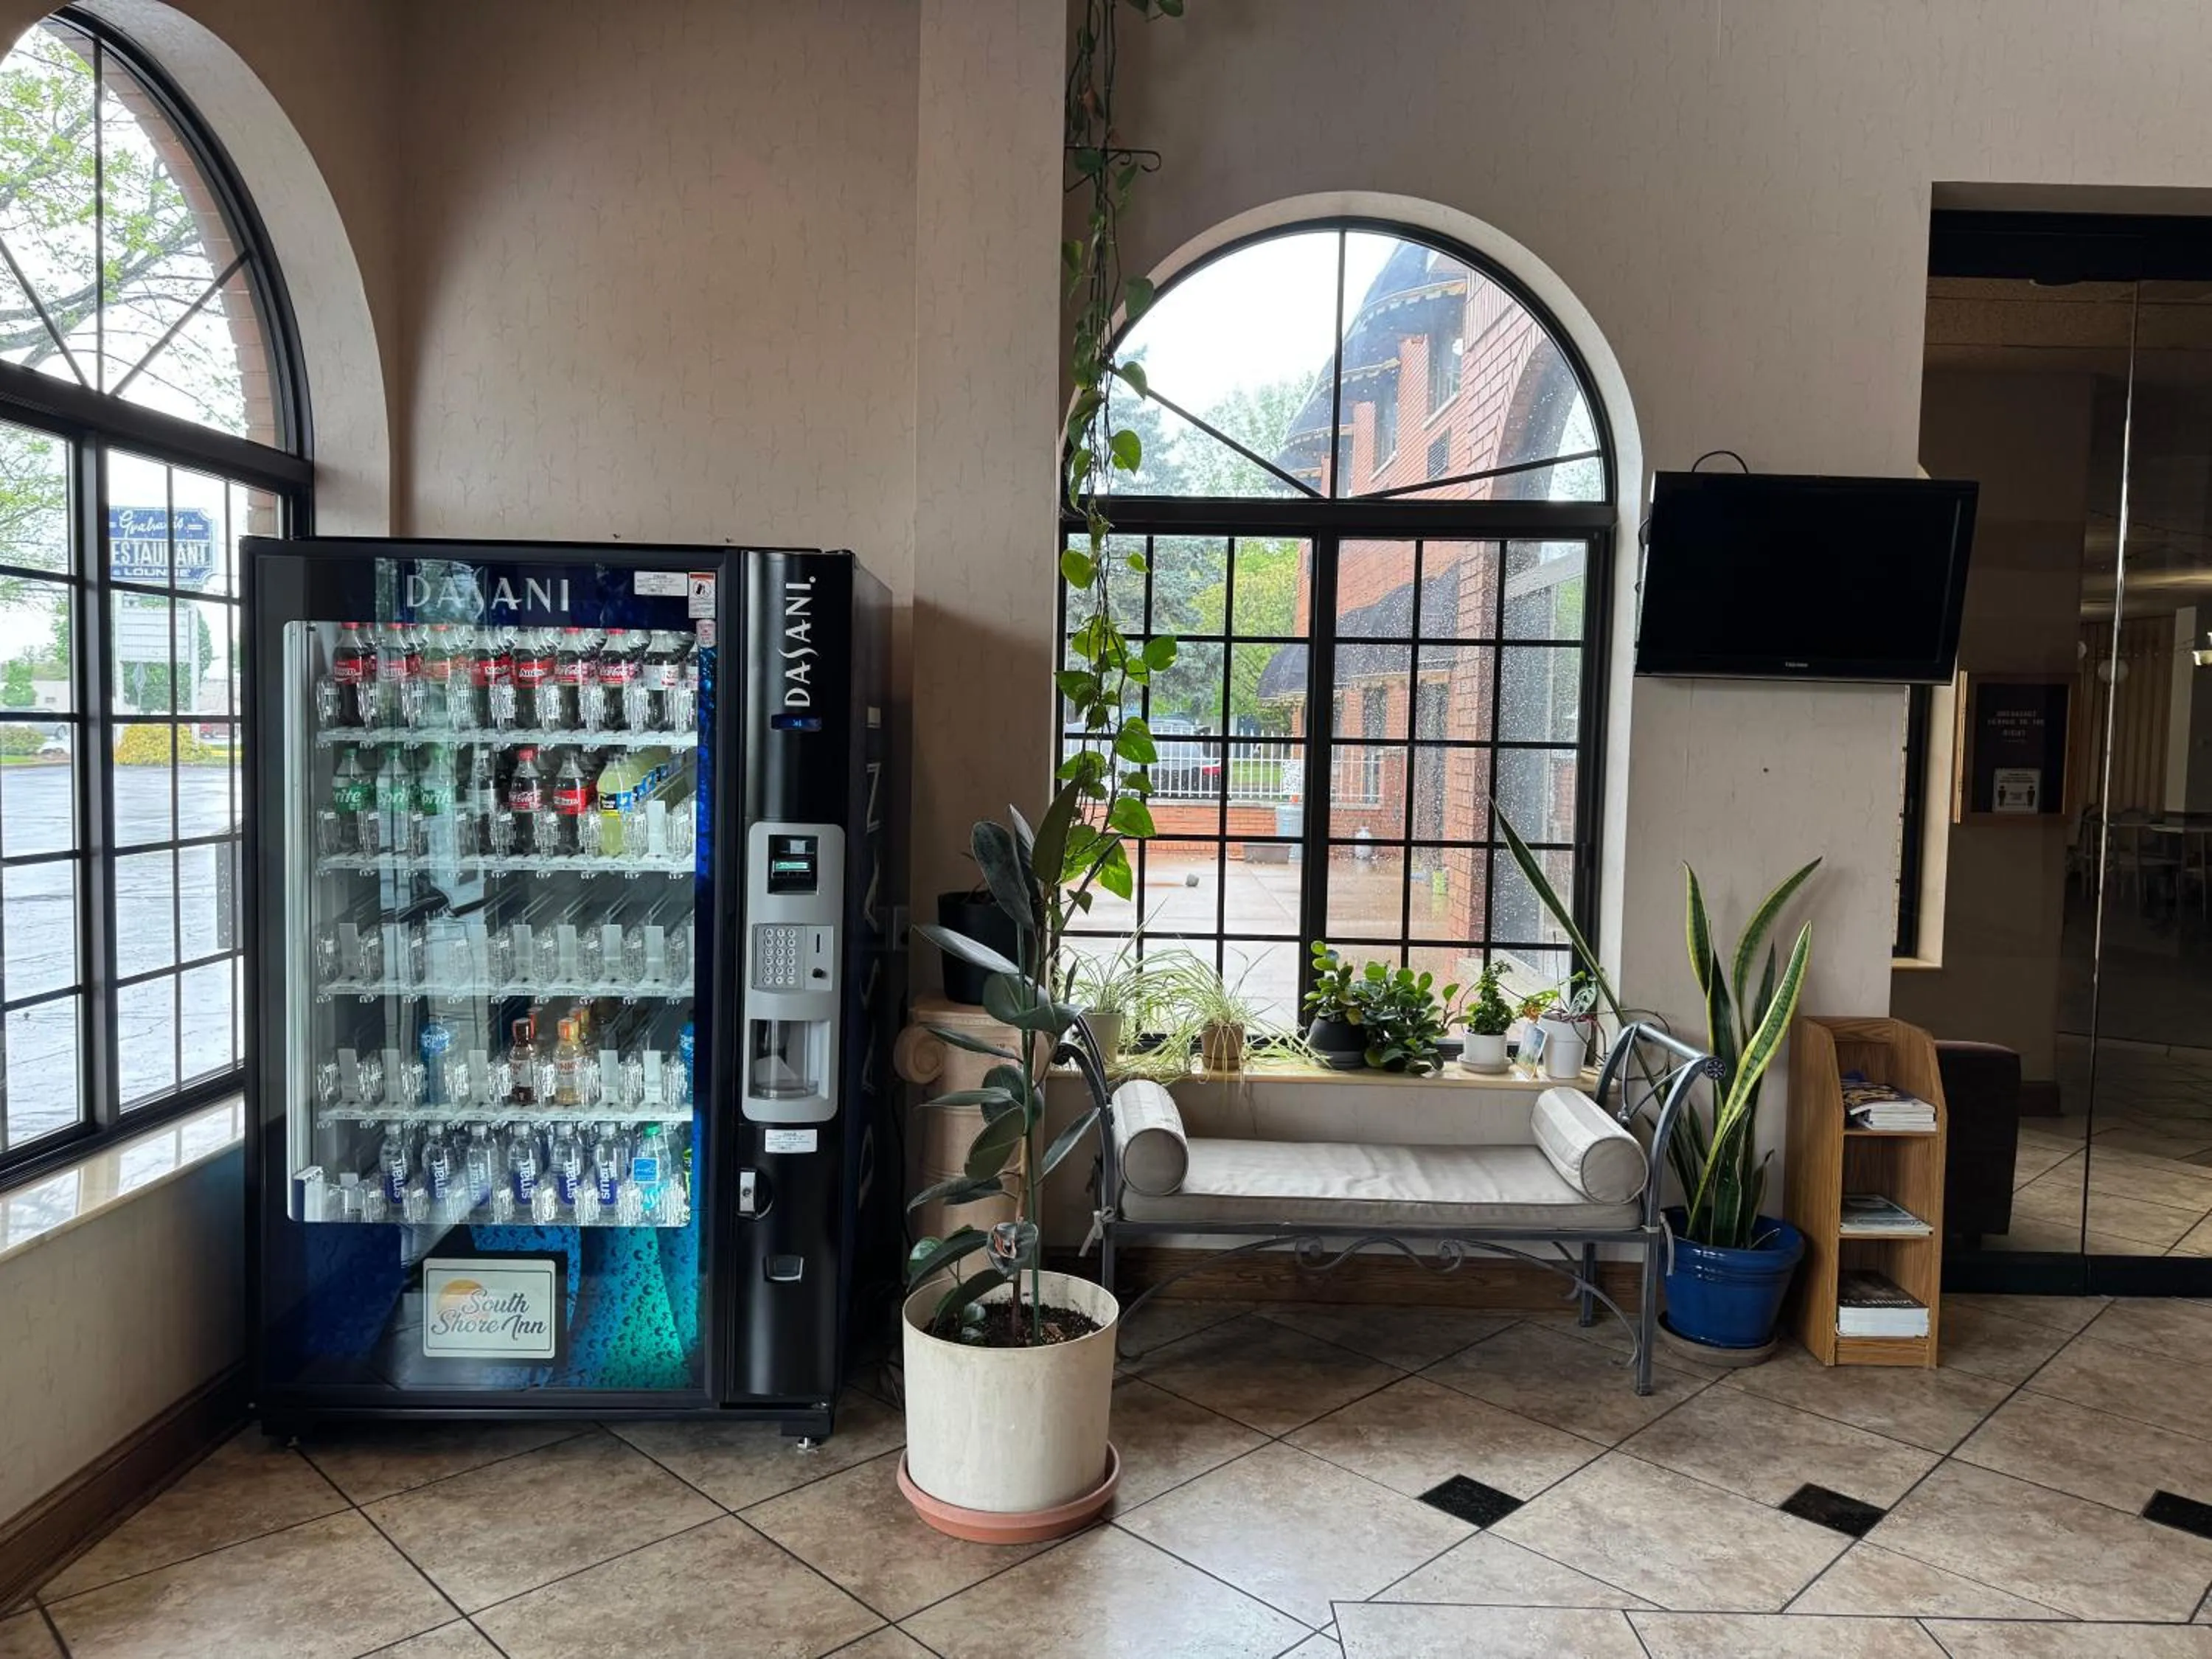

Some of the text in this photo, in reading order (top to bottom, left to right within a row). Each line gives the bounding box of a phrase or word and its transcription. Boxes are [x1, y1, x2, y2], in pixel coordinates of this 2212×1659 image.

[111, 540, 208, 566] ESTAUANT
[124, 568, 191, 577] LOUNE
[406, 566, 569, 619] DASANI
[390, 1158, 404, 1199] smart
[431, 1159, 445, 1198] smart
[518, 1159, 532, 1200] smart
[600, 1160, 611, 1200] smart
[462, 1289, 529, 1315] South
[431, 1308, 548, 1340] Shore Inn
